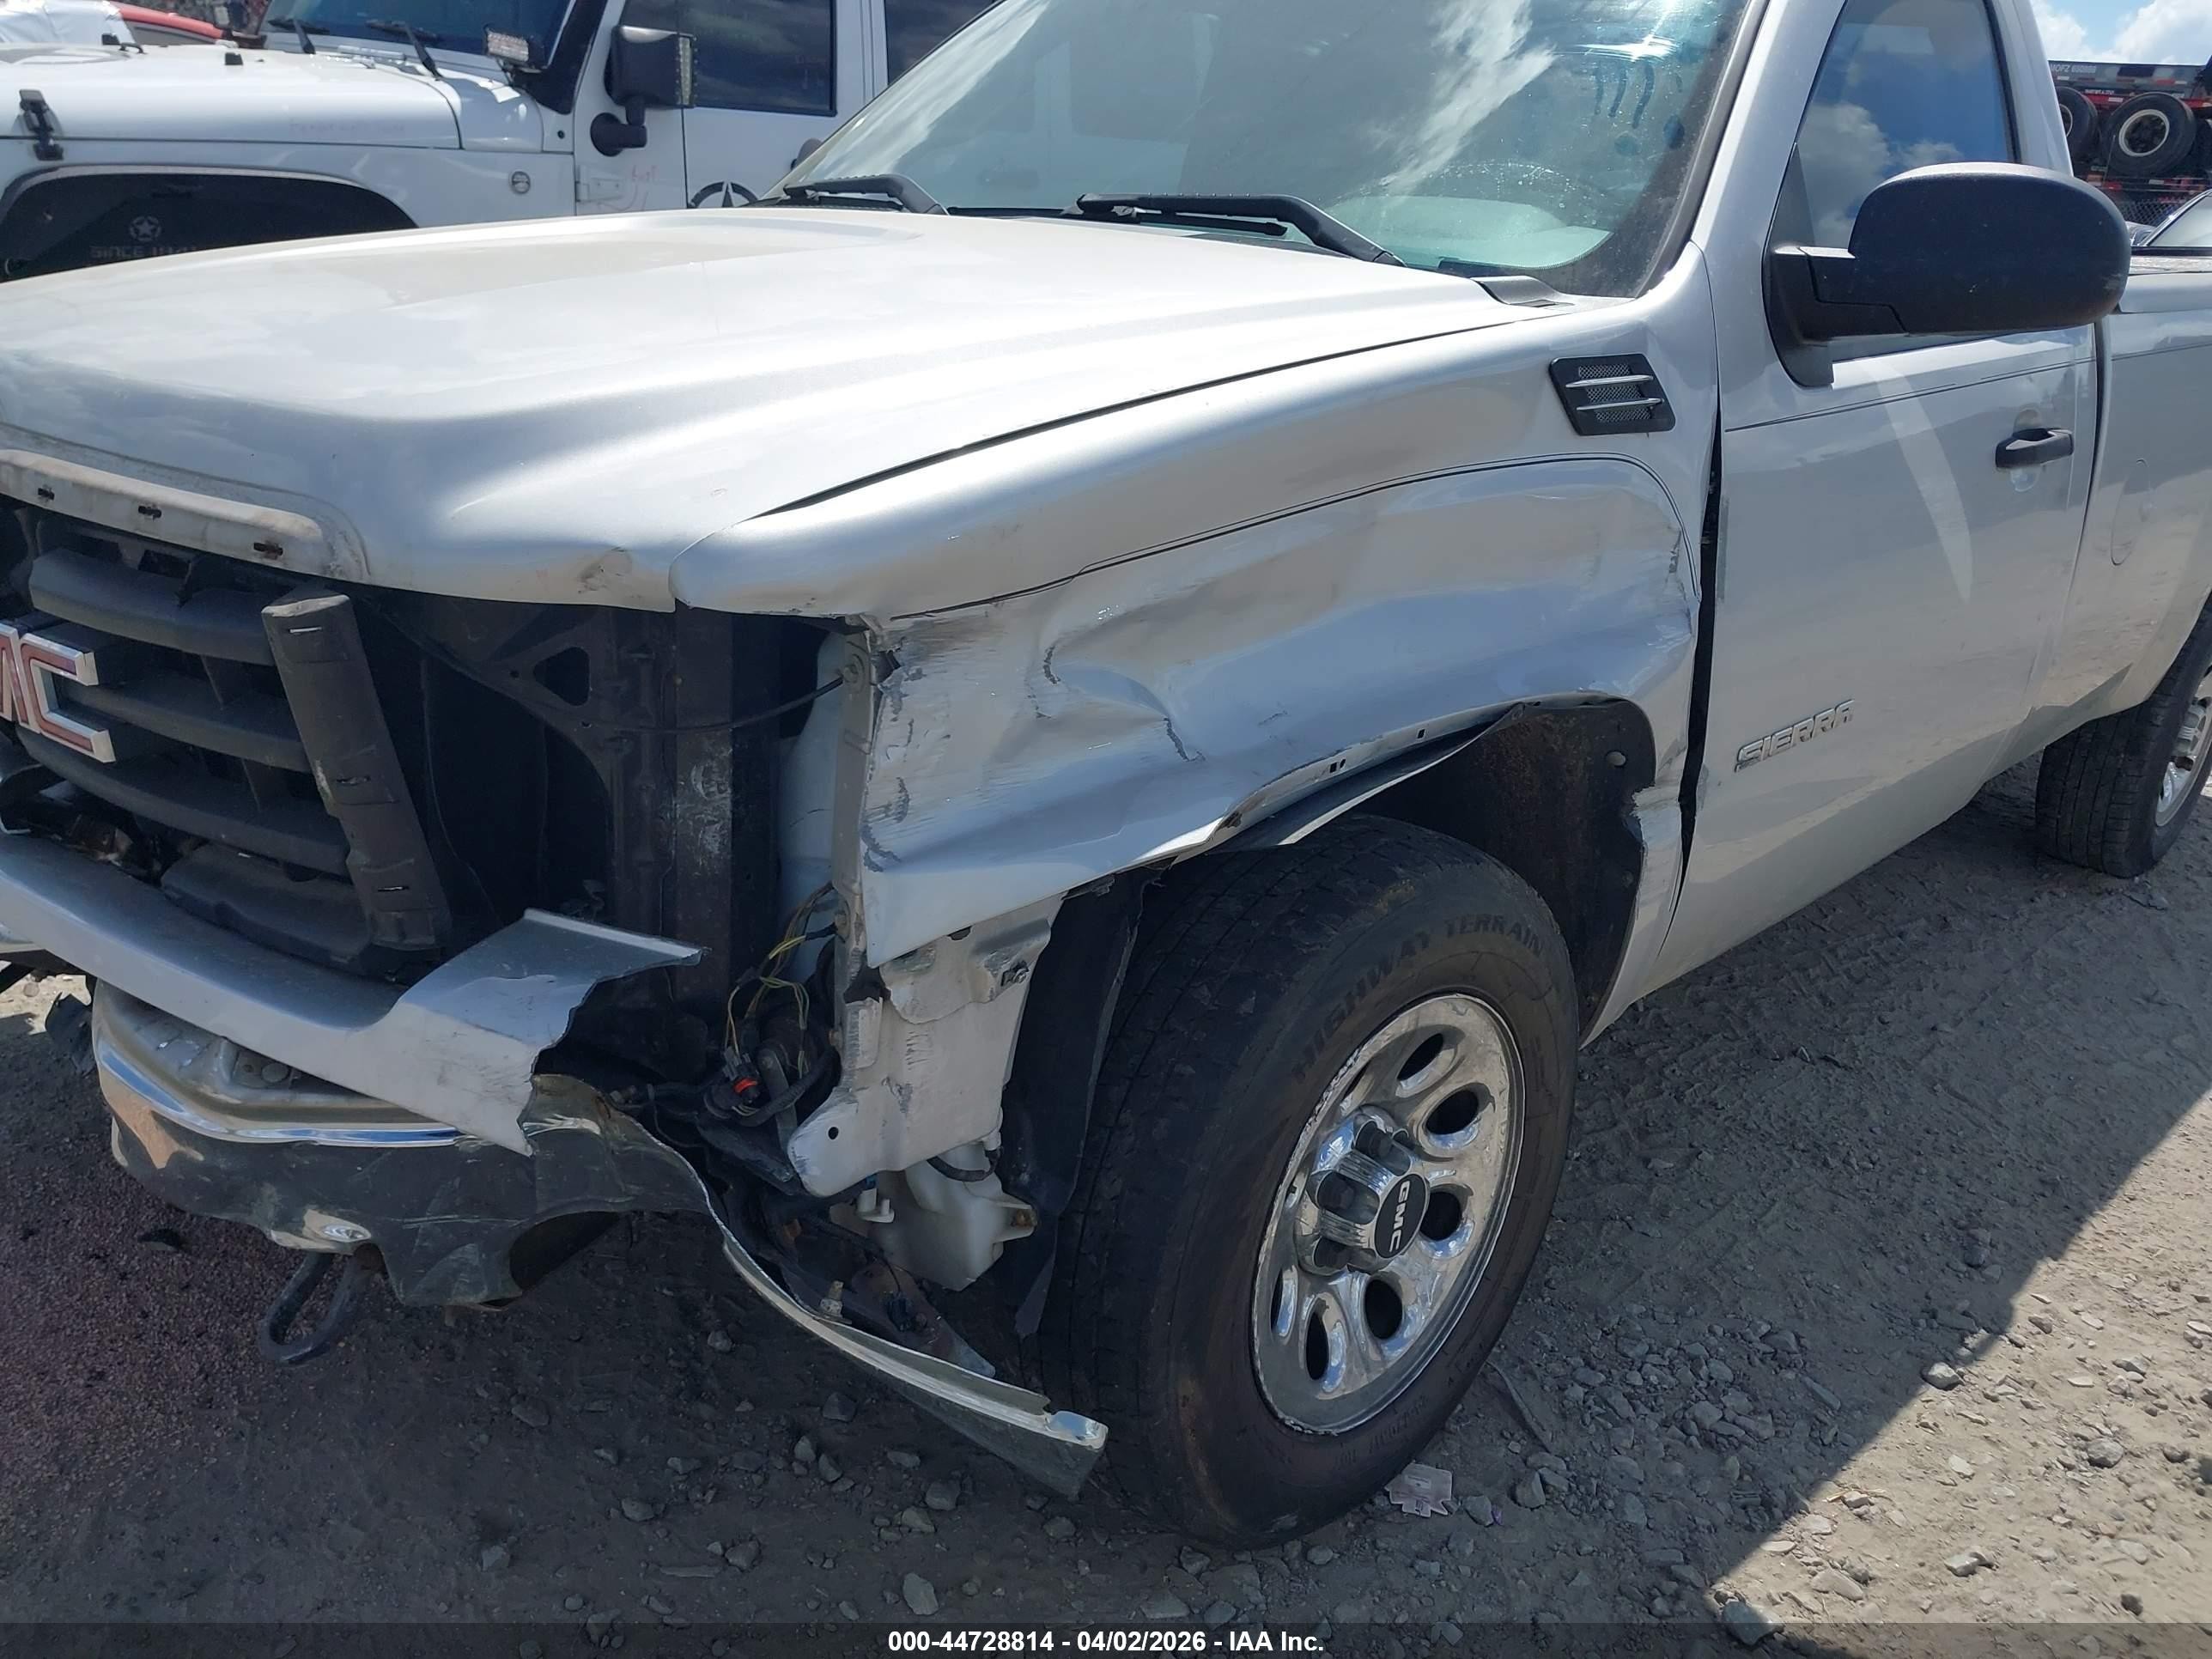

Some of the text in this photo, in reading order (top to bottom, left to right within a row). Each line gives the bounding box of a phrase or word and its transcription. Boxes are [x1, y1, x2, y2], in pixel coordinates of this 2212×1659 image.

[1734, 699, 1855, 773] SIERRA
[1291, 914, 1544, 1084] HIGHWAY TERRAIN
[1389, 1180, 1411, 1253] GMC
